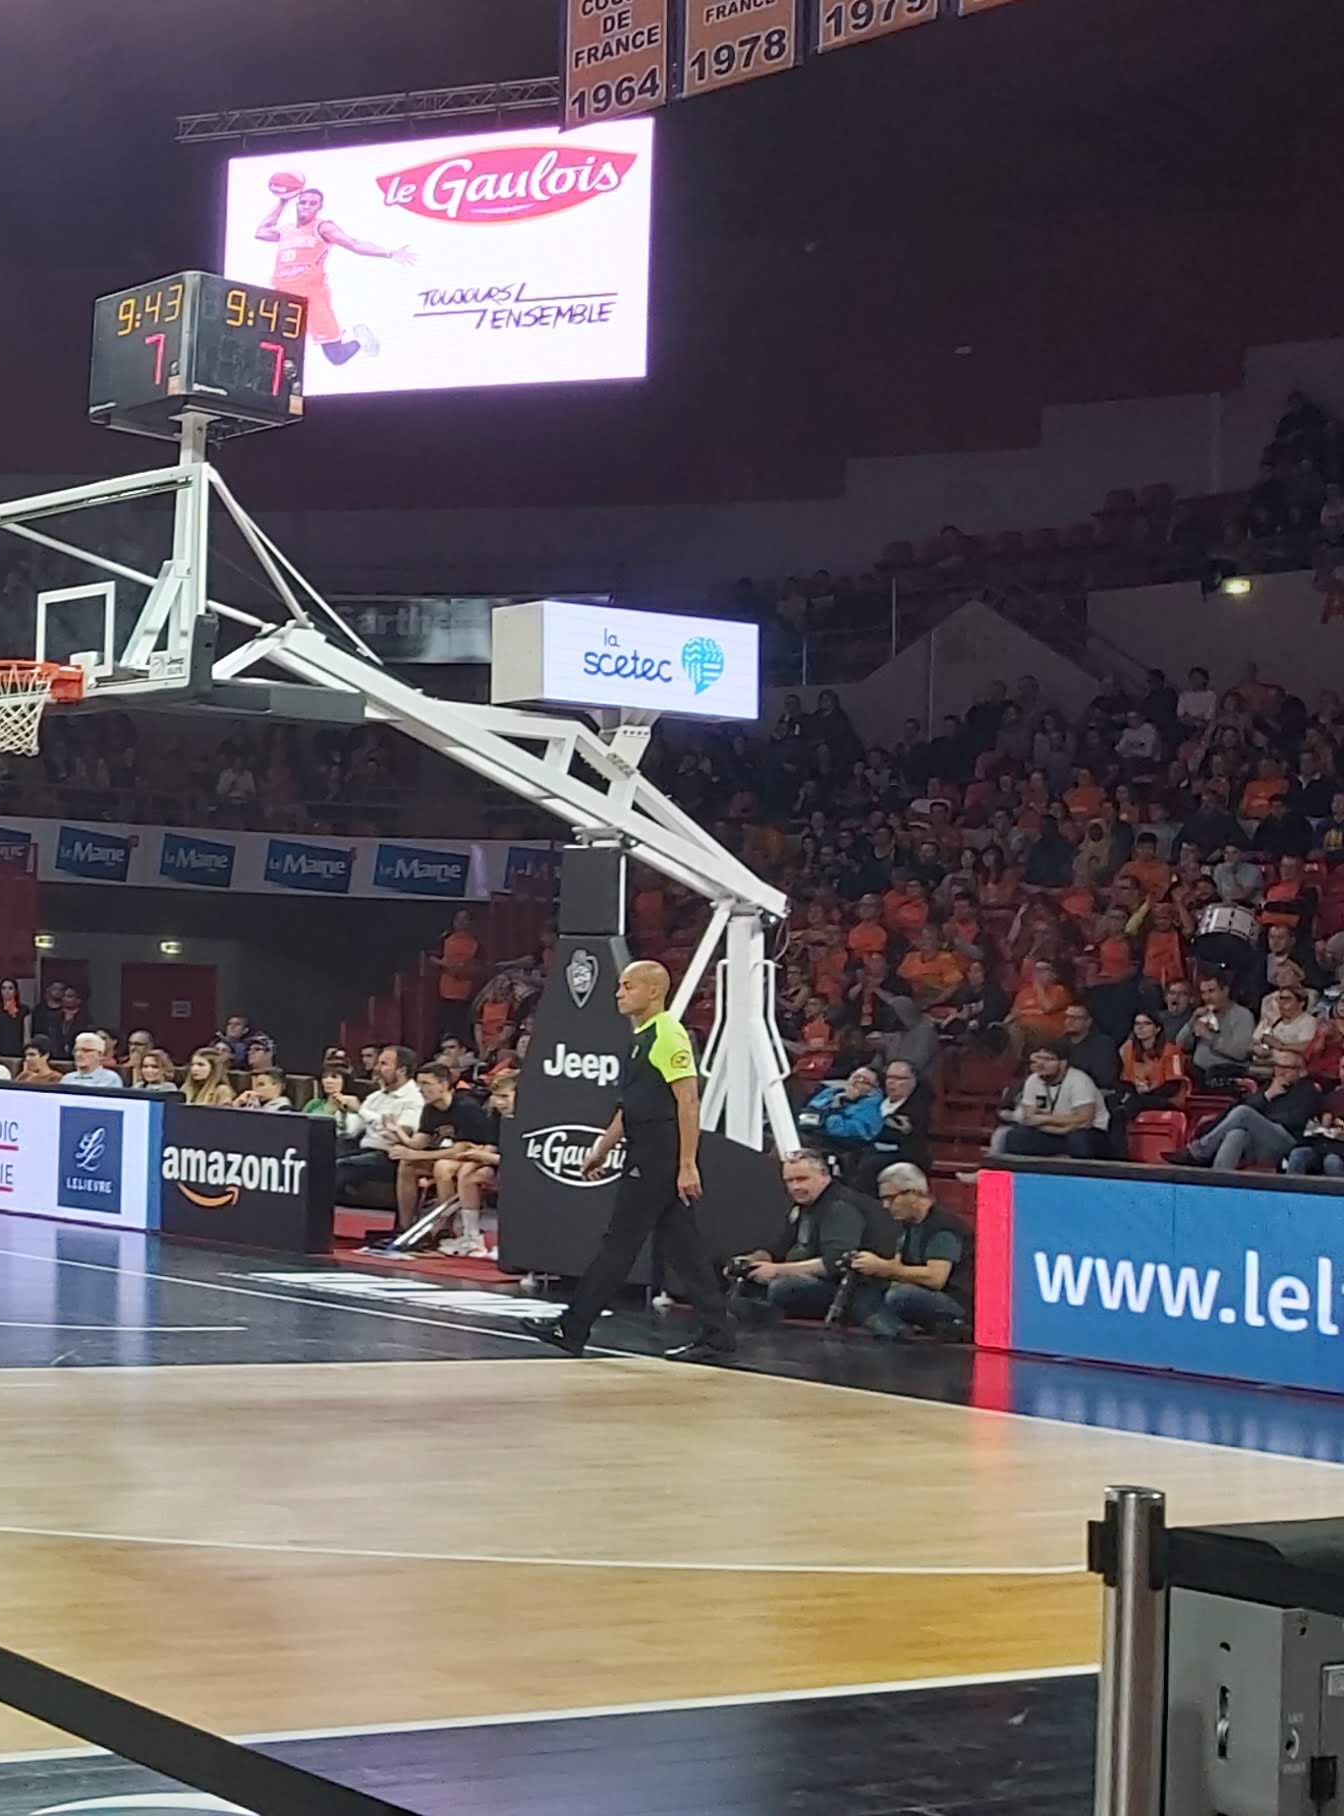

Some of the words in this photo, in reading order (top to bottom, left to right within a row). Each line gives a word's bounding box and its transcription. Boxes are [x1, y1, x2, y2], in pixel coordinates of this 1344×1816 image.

[602, 10, 631, 34] DE
[704, 0, 778, 23] FRANC
[574, 26, 660, 68] FRANCE
[690, 27, 789, 82] 1978
[571, 67, 660, 119] 1964
[384, 177, 417, 206] le
[422, 149, 622, 219] Gaulois
[117, 284, 184, 336] 9:43
[226, 289, 303, 339] 9:43
[490, 302, 616, 329] ENSEMBLE
[144, 332, 166, 385] 7
[259, 341, 286, 397] 7
[603, 627, 620, 648] la
[583, 649, 673, 683] scetec
[543, 1043, 619, 1086] Jeep
[162, 1145, 307, 1195] amazon.fr
[1032, 1249, 1344, 1337] www.lel
